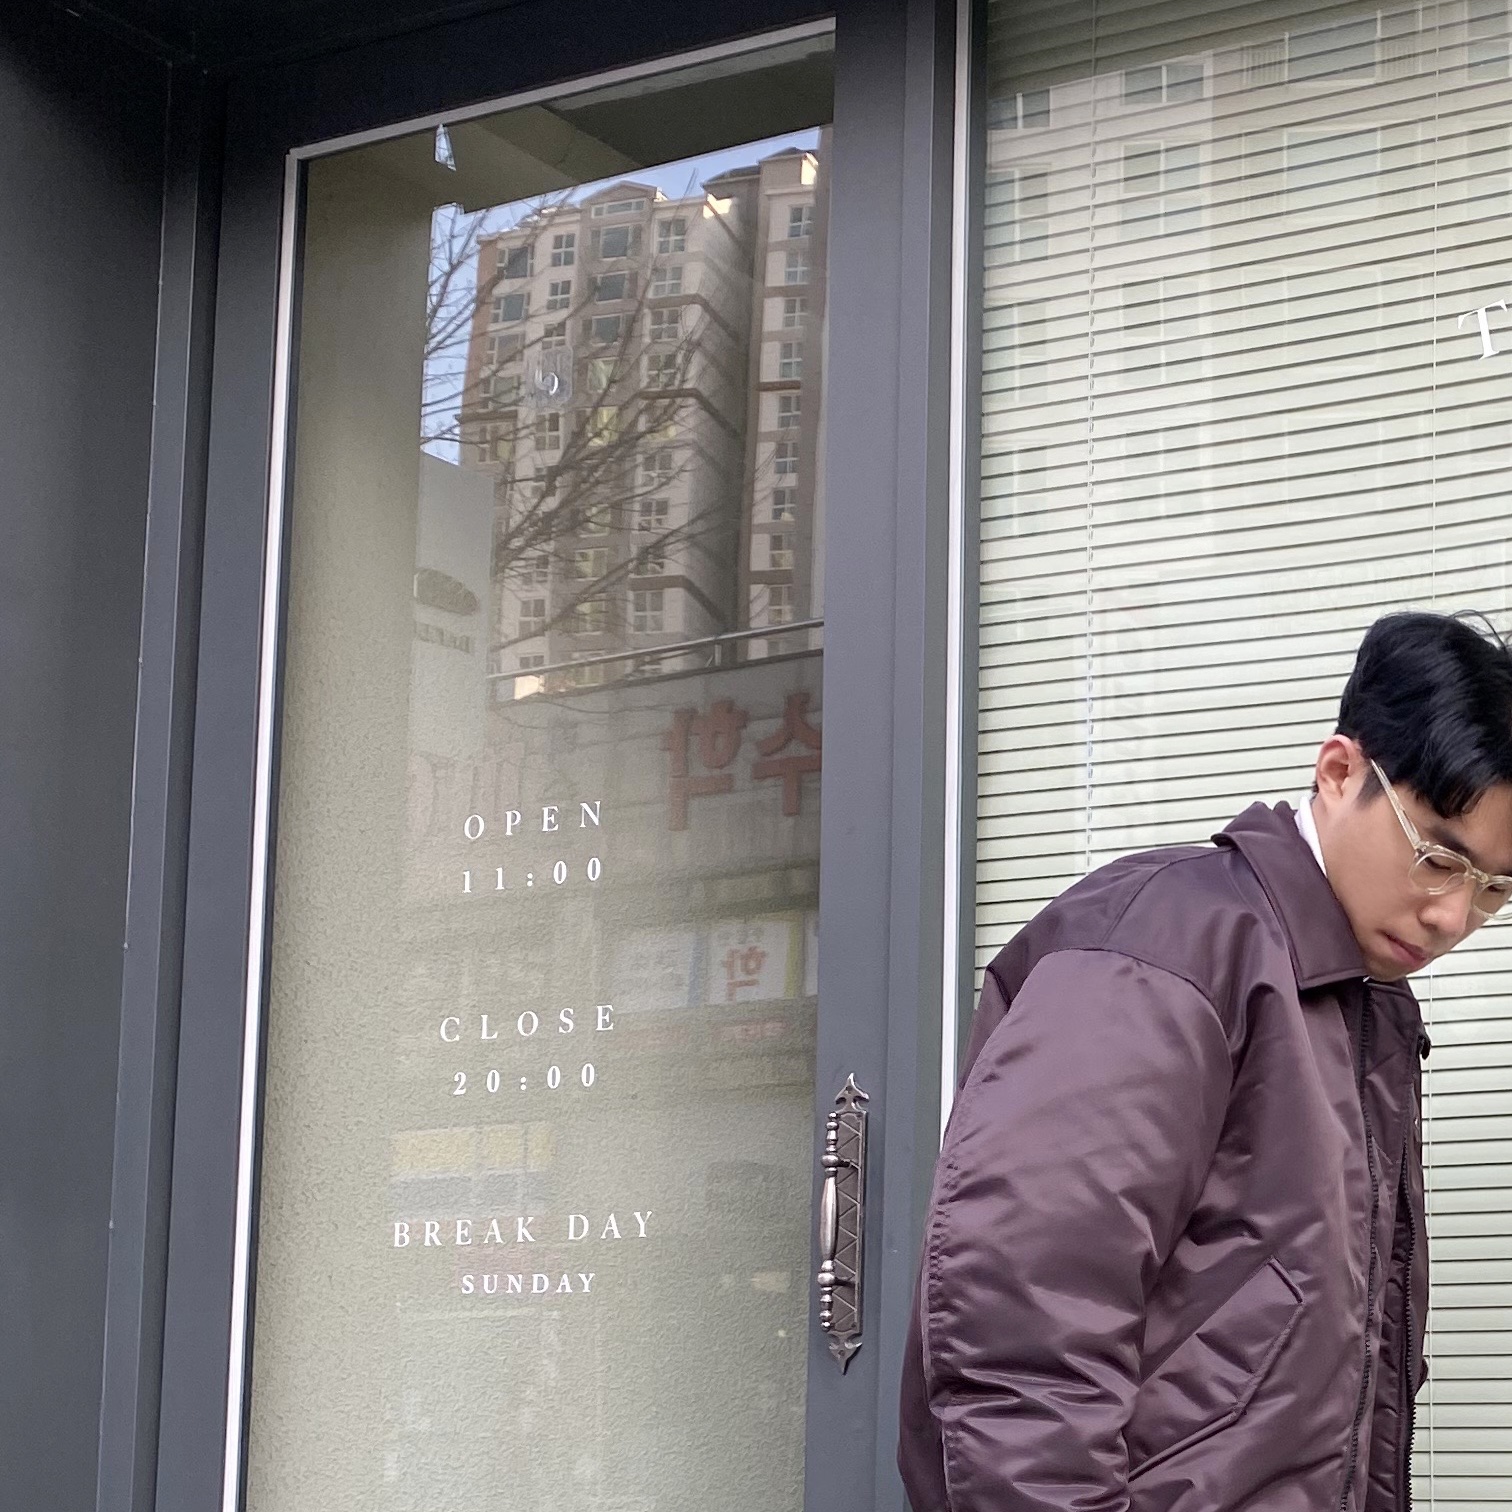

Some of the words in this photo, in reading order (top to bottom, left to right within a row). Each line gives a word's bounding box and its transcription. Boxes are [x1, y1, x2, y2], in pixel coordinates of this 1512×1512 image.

[464, 800, 602, 841] OPEN
[461, 857, 602, 894] 11:00
[440, 1004, 616, 1043] CLOSE
[453, 1062, 597, 1096] 20:00
[393, 1215, 538, 1250] BREAK
[567, 1210, 656, 1243] DAY
[460, 1271, 598, 1296] SUNDAY
